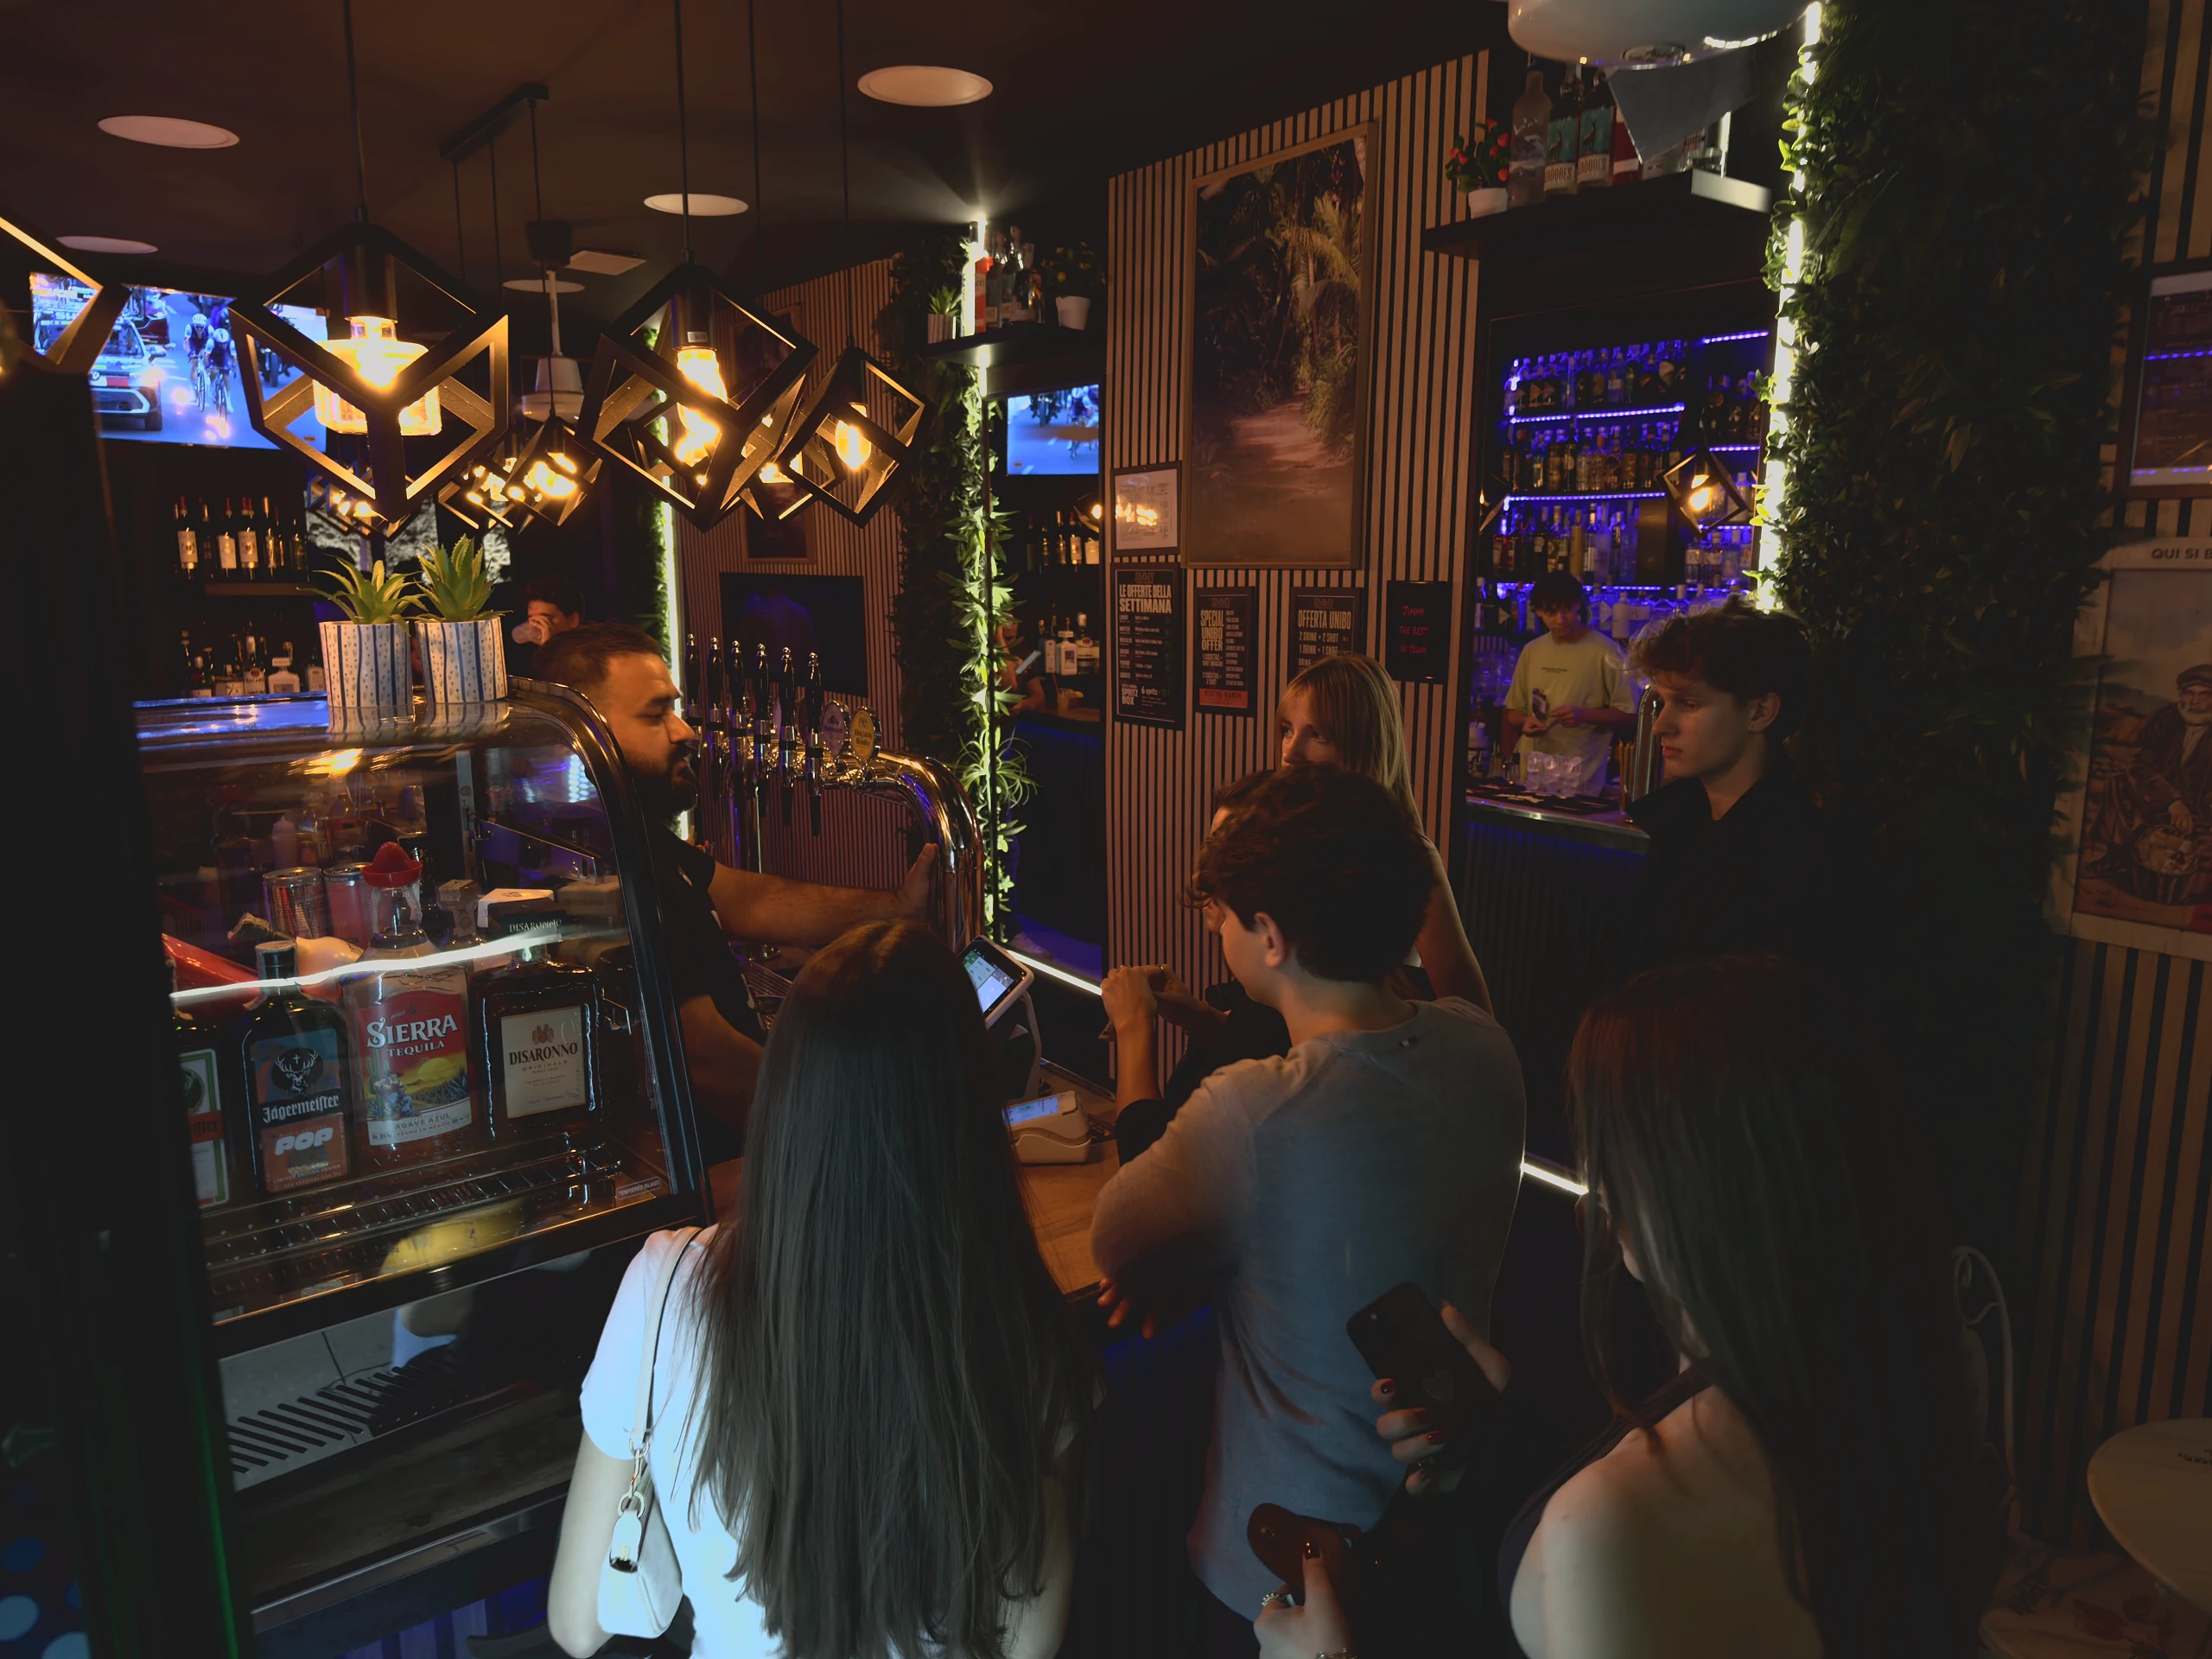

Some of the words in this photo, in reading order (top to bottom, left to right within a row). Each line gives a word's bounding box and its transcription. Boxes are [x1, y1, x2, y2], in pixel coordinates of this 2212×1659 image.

[2152, 548, 2179, 559] QUI
[2184, 548, 2198, 559] SI
[1135, 571, 1154, 583] JIMMY
[1119, 584, 1126, 598] LE
[1127, 584, 1153, 598] OFFERTE
[1153, 584, 1172, 599] DELLA
[1119, 598, 1172, 613] SETTIMANA
[1402, 605, 1425, 617] JIMMY
[1200, 609, 1224, 627] SPECIAL
[1298, 609, 1327, 628] OFFERTA
[1329, 610, 1351, 630] UNIBO
[1201, 626, 1224, 639] UNIBO
[1413, 626, 1429, 635] BEST
[1299, 632, 1302, 641] 2
[1303, 632, 1317, 641] DRINK
[1322, 632, 1325, 642] 2
[1326, 632, 1339, 643] SHOT
[1201, 639, 1223, 652] OFFER
[1303, 645, 1317, 655] DRINK
[1325, 646, 1338, 656] SHOT
[1409, 645, 1427, 654] TOWN
[1122, 696, 1135, 705] BOX
[509, 918, 562, 933] DISARONNO
[366, 1014, 459, 1049] SIERRA
[386, 1039, 445, 1058] TEQUILA
[509, 1041, 578, 1065] DISARONNO
[395, 1119, 426, 1130] AGAVE
[429, 1113, 450, 1123] AZUL
[274, 1127, 334, 1156] POP
[644, 1179, 660, 1189] GLASS
